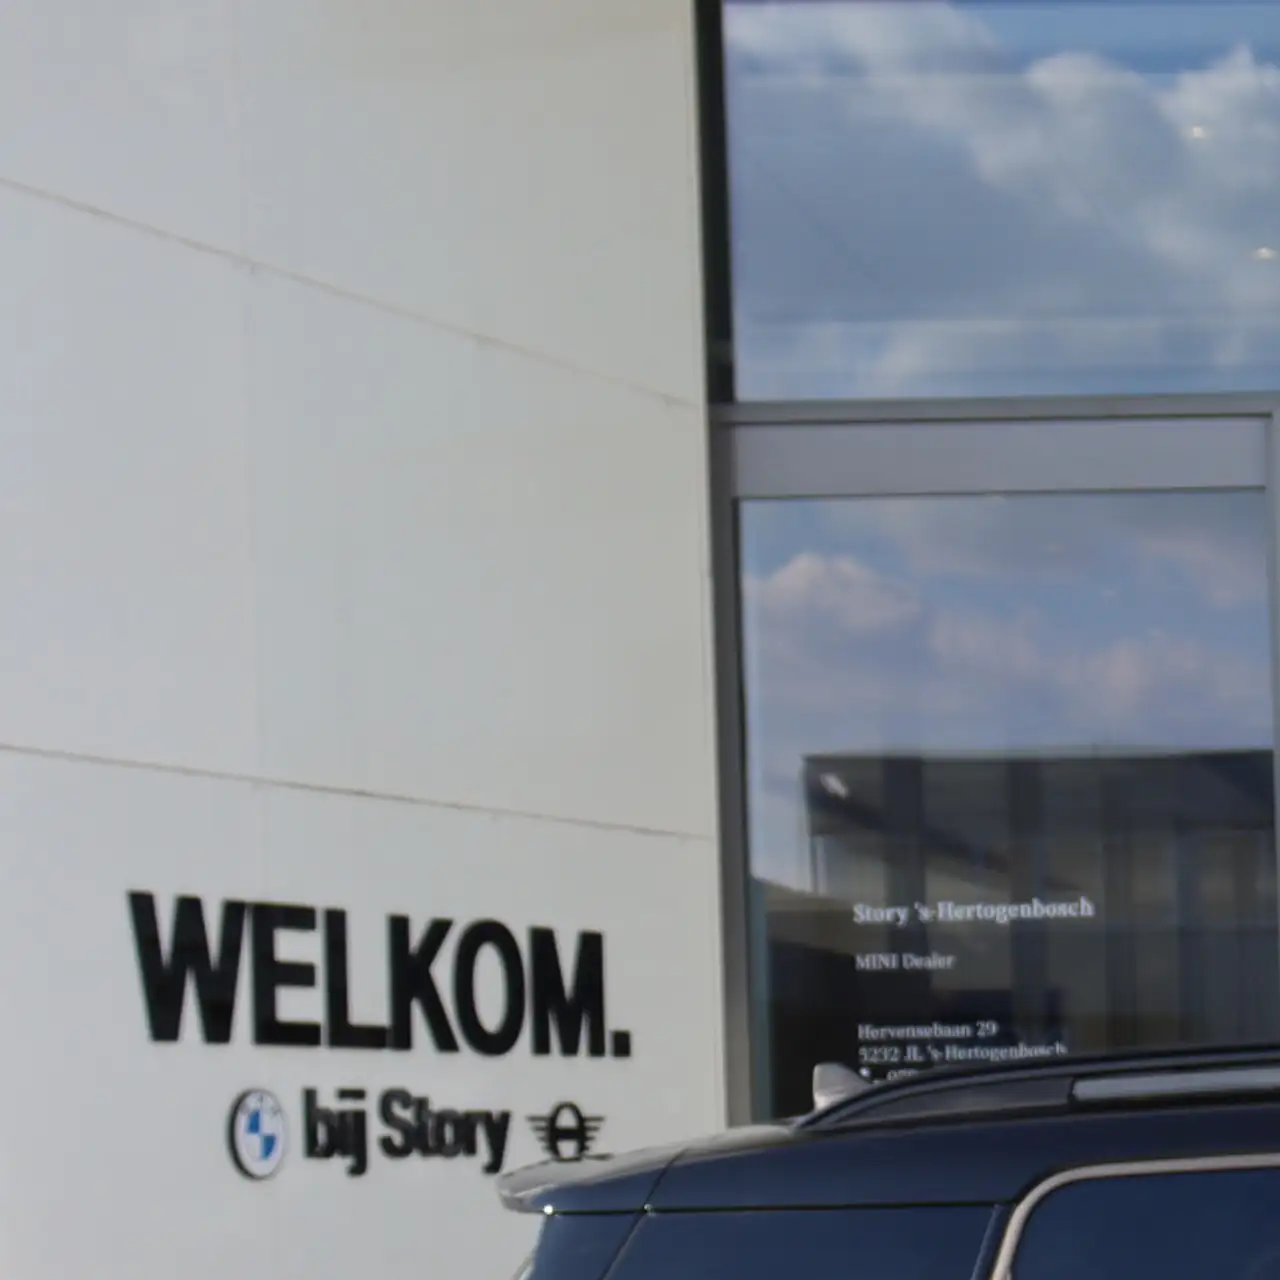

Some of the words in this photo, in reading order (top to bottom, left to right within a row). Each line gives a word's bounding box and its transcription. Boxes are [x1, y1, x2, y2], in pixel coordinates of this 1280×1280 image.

[853, 903, 908, 926] Story
[855, 954, 898, 970] MINI
[902, 953, 955, 970] Dealer
[127, 890, 631, 1057] WELKOM.
[858, 1022, 971, 1040] Hervensebaan
[976, 1020, 998, 1037] 29
[859, 1046, 899, 1063] 5232
[302, 1088, 368, 1176] bij
[379, 1088, 511, 1174] Story
